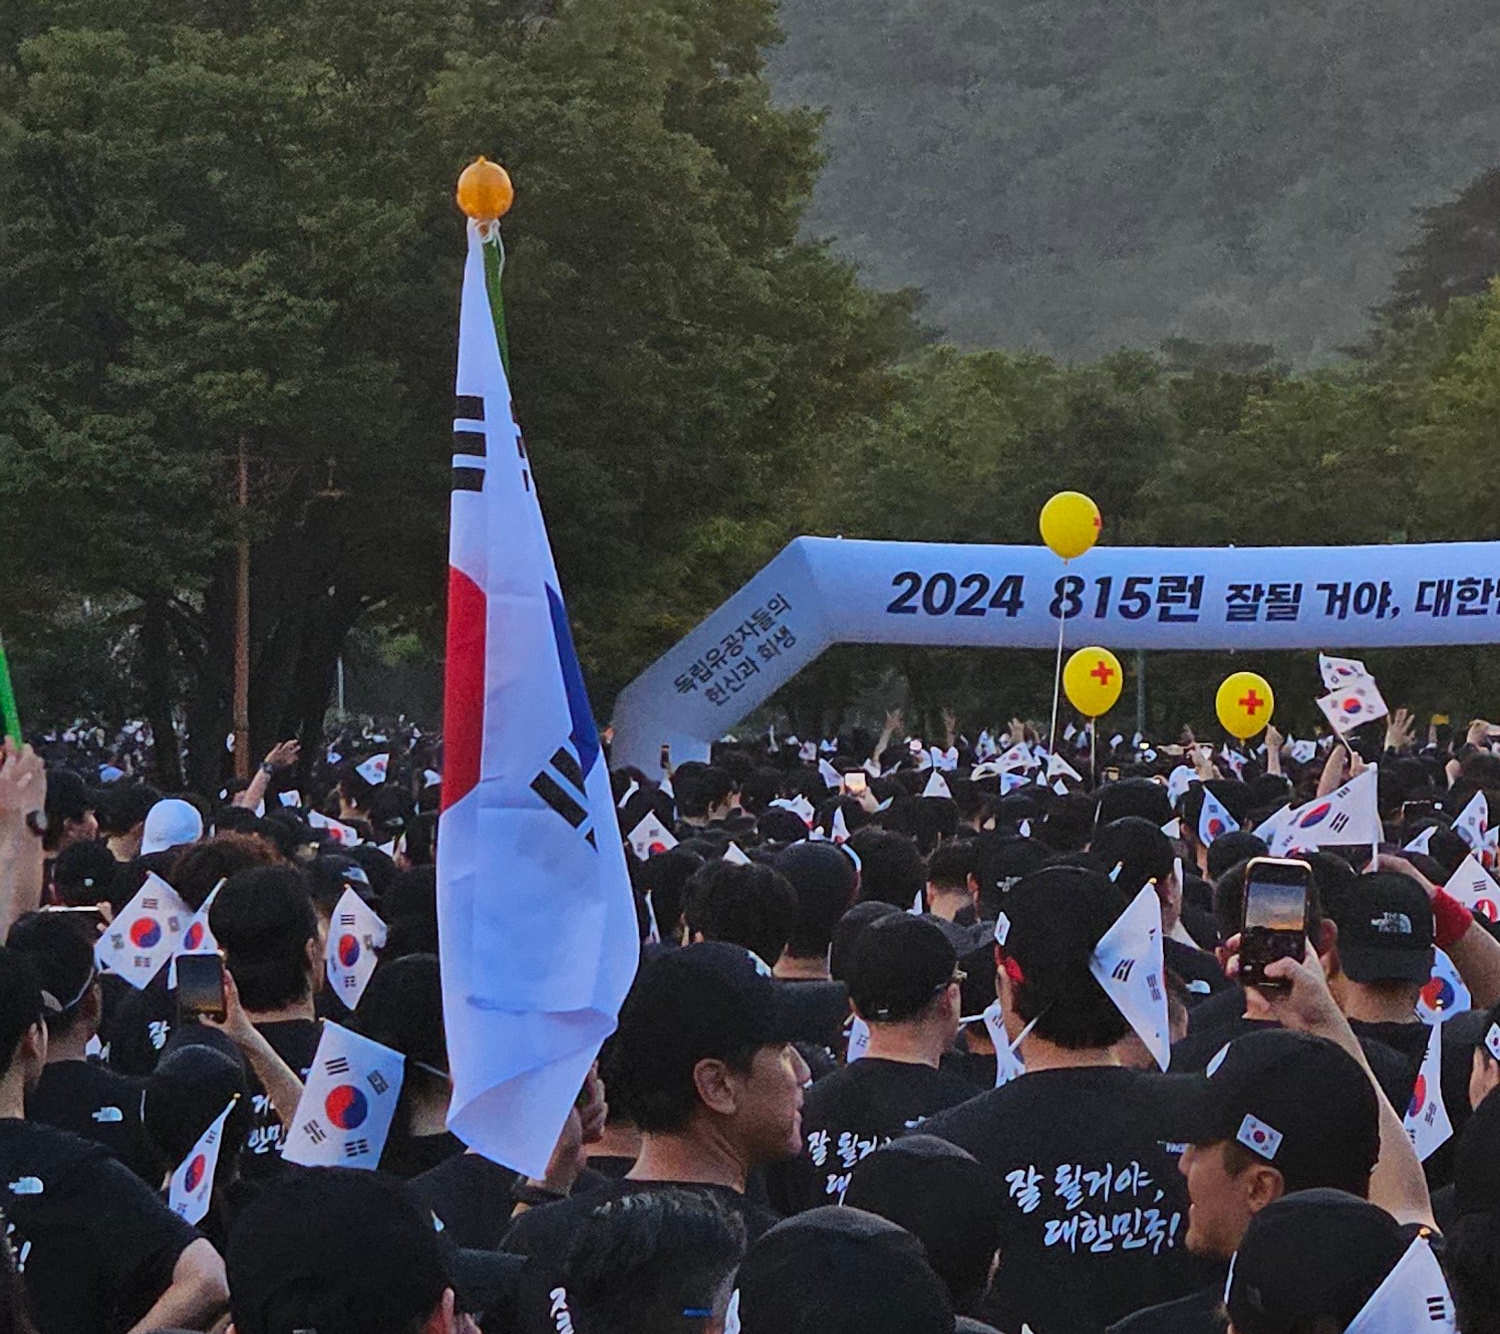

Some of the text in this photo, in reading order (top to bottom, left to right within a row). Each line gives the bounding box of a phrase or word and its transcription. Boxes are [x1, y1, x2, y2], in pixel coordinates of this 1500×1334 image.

[887, 571, 1025, 618] 2024
[1049, 575, 1205, 622] 815런
[1225, 582, 1303, 622] 잘될
[1316, 580, 1401, 620] 거야,
[674, 593, 792, 694] 독립유공자들의
[705, 625, 796, 707] 헌신과 희생
[807, 1129, 832, 1167] 잘
[1005, 1161, 1165, 1213] 잘 될거야,
[1043, 1208, 1182, 1255] 대한민국!
